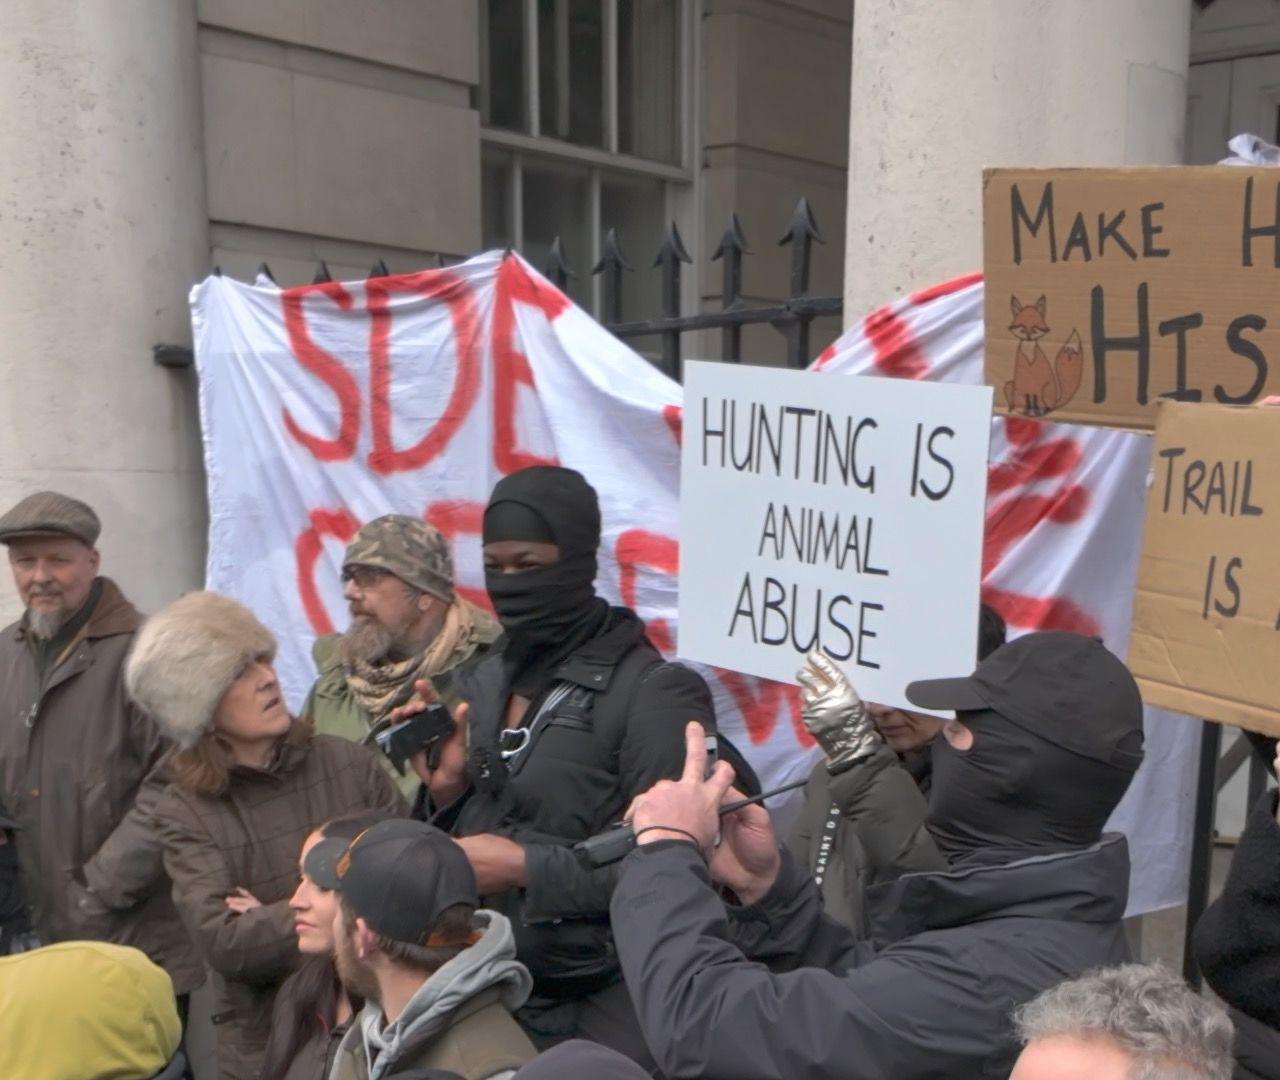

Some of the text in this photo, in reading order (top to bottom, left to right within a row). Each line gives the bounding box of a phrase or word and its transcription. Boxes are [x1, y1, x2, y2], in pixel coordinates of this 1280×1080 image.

[1010, 181, 1170, 264] MAKE
[702, 397, 956, 501] HUNTING IS
[1159, 447, 1264, 517] TRAIL
[758, 502, 890, 576] ANIMAL
[728, 571, 885, 670] ABUSE
[1203, 556, 1242, 620] IS
